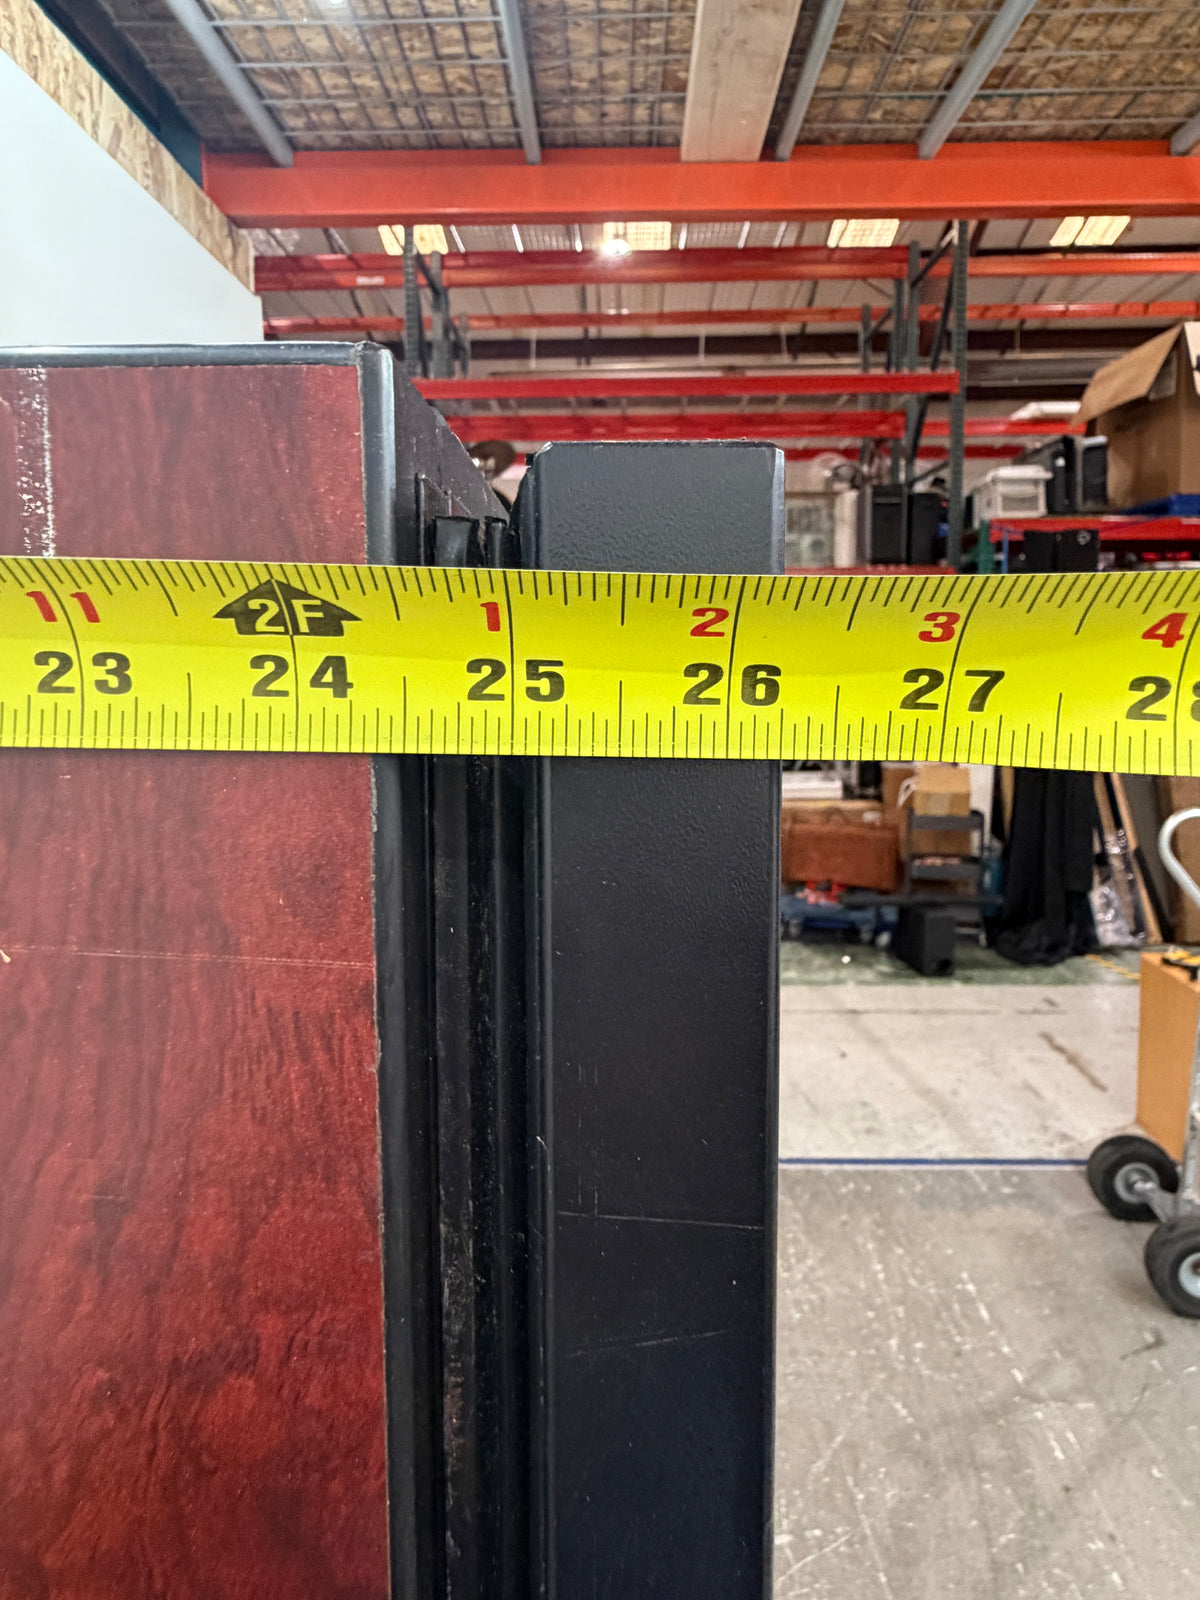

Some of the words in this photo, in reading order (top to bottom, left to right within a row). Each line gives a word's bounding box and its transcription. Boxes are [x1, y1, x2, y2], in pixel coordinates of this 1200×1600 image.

[247, 598, 328, 635] 2F
[480, 601, 501, 632] 1
[690, 607, 729, 638] 2
[917, 611, 960, 643] 3
[1141, 612, 1188, 648] 4
[33, 650, 133, 695] 23
[249, 654, 354, 699] 24
[466, 658, 566, 702] 25
[682, 662, 782, 707] 26
[900, 667, 1006, 713] 27
[1125, 675, 1200, 722] 2
